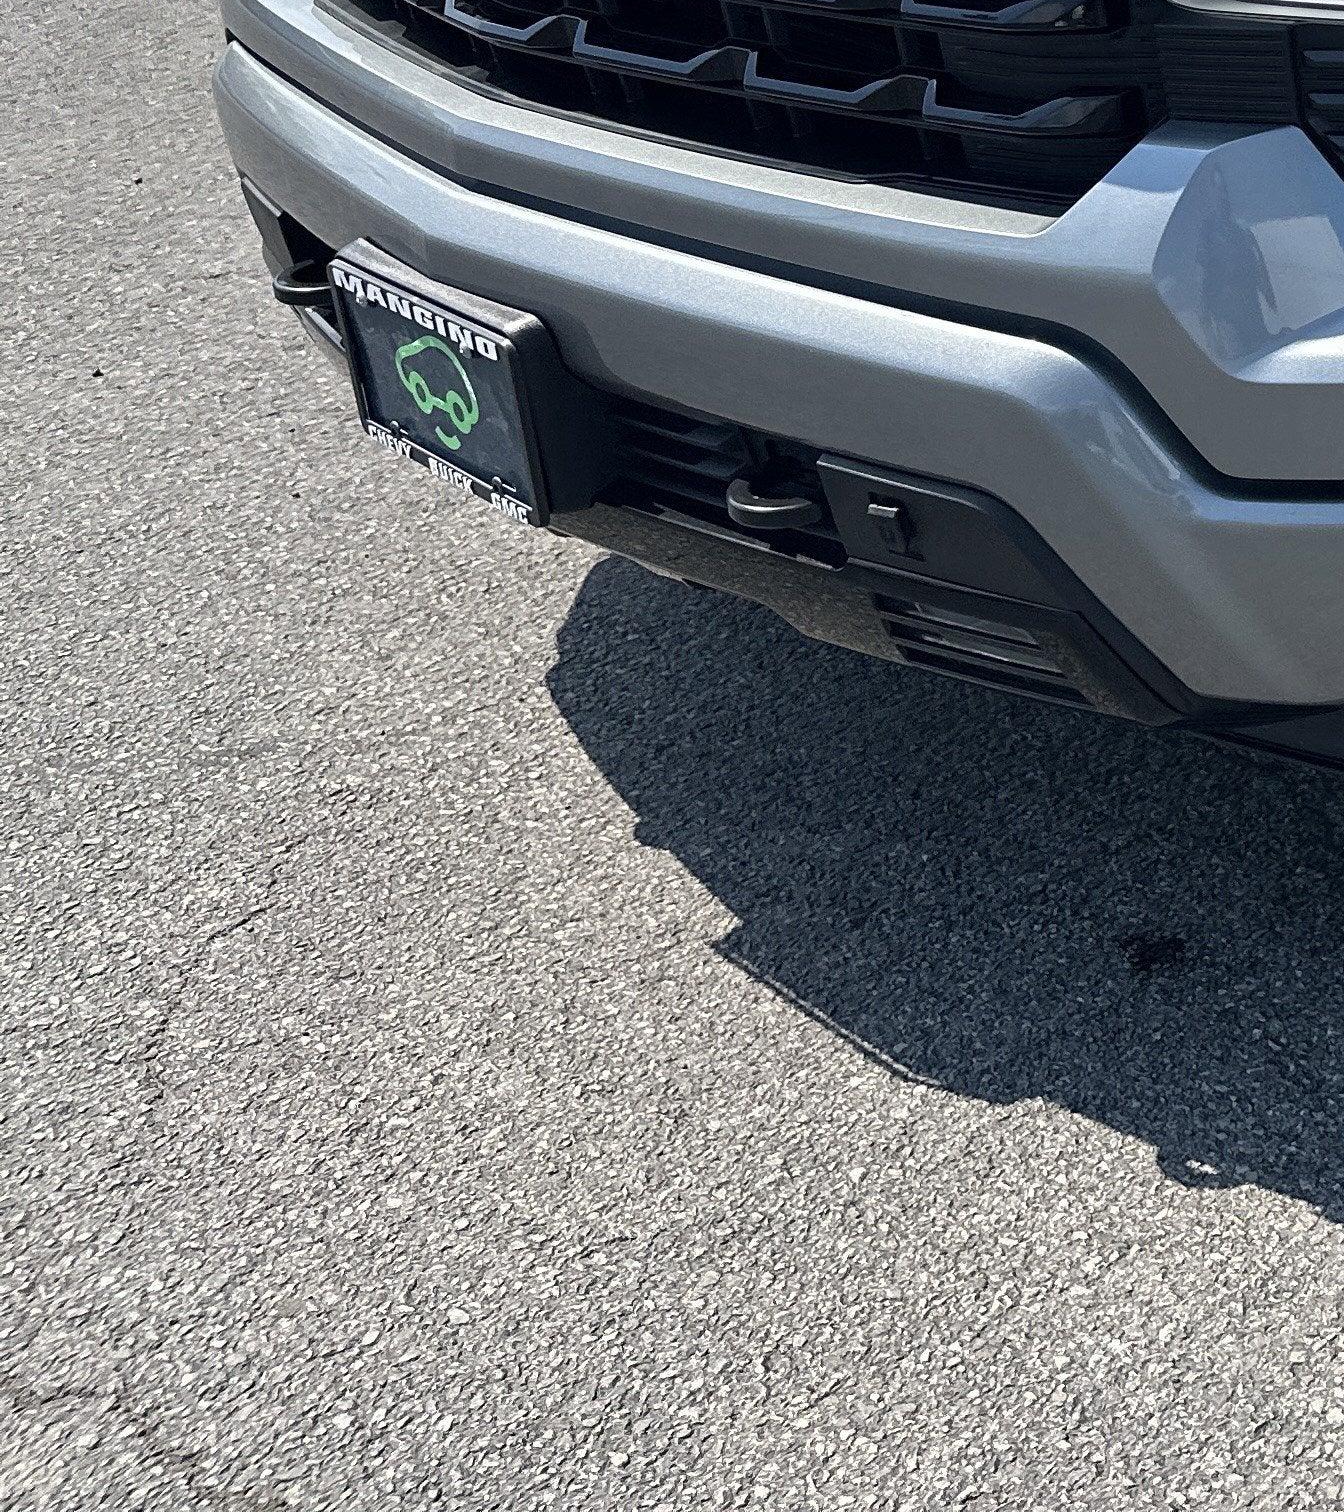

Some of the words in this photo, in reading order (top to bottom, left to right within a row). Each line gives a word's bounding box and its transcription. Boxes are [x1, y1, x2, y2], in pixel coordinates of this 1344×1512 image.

[332, 268, 498, 361] MANGINO
[367, 425, 413, 460] CHEVY
[427, 456, 473, 494] BUICK
[490, 492, 530, 525] GMC
